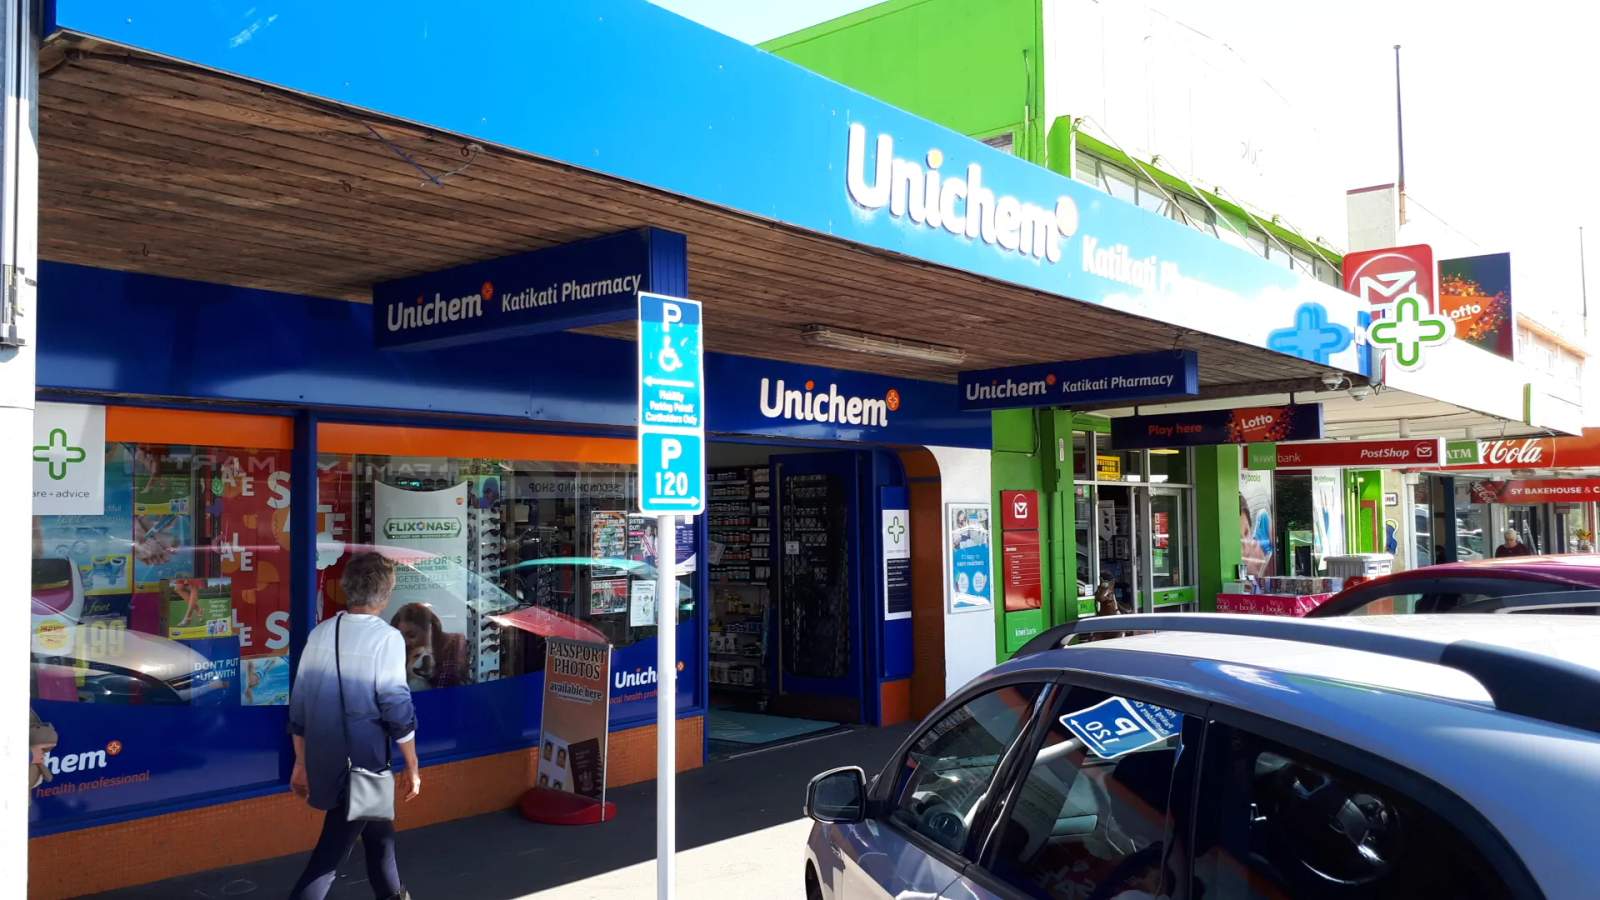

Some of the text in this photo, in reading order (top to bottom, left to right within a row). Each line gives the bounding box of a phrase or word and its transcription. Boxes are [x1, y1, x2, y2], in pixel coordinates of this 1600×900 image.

[846, 122, 1062, 264] Unichem
[1082, 234, 1158, 291] Katikati
[387, 273, 642, 332] Unichem Katikati Pharmacy
[662, 303, 682, 332] P
[966, 373, 1174, 401] Unichem Katikati Pharmacy
[760, 377, 888, 427] Unichem
[1241, 413, 1273, 430] Lotto
[661, 438, 682, 469] P
[1360, 447, 1410, 460] PostShop
[32, 490, 47, 498] are
[55, 489, 90, 498] advice
[655, 472, 688, 496] 120
[1525, 486, 1582, 496] BAKEHOUSE
[389, 521, 457, 532] FLIXONASE
[226, 657, 240, 667] PUT
[550, 641, 607, 663] PASSPORT
[215, 668, 236, 679] WITH
[554, 658, 600, 680] PHOTOS
[549, 681, 585, 696] available
[45, 750, 107, 775] hem
[36, 769, 150, 798] health professional
